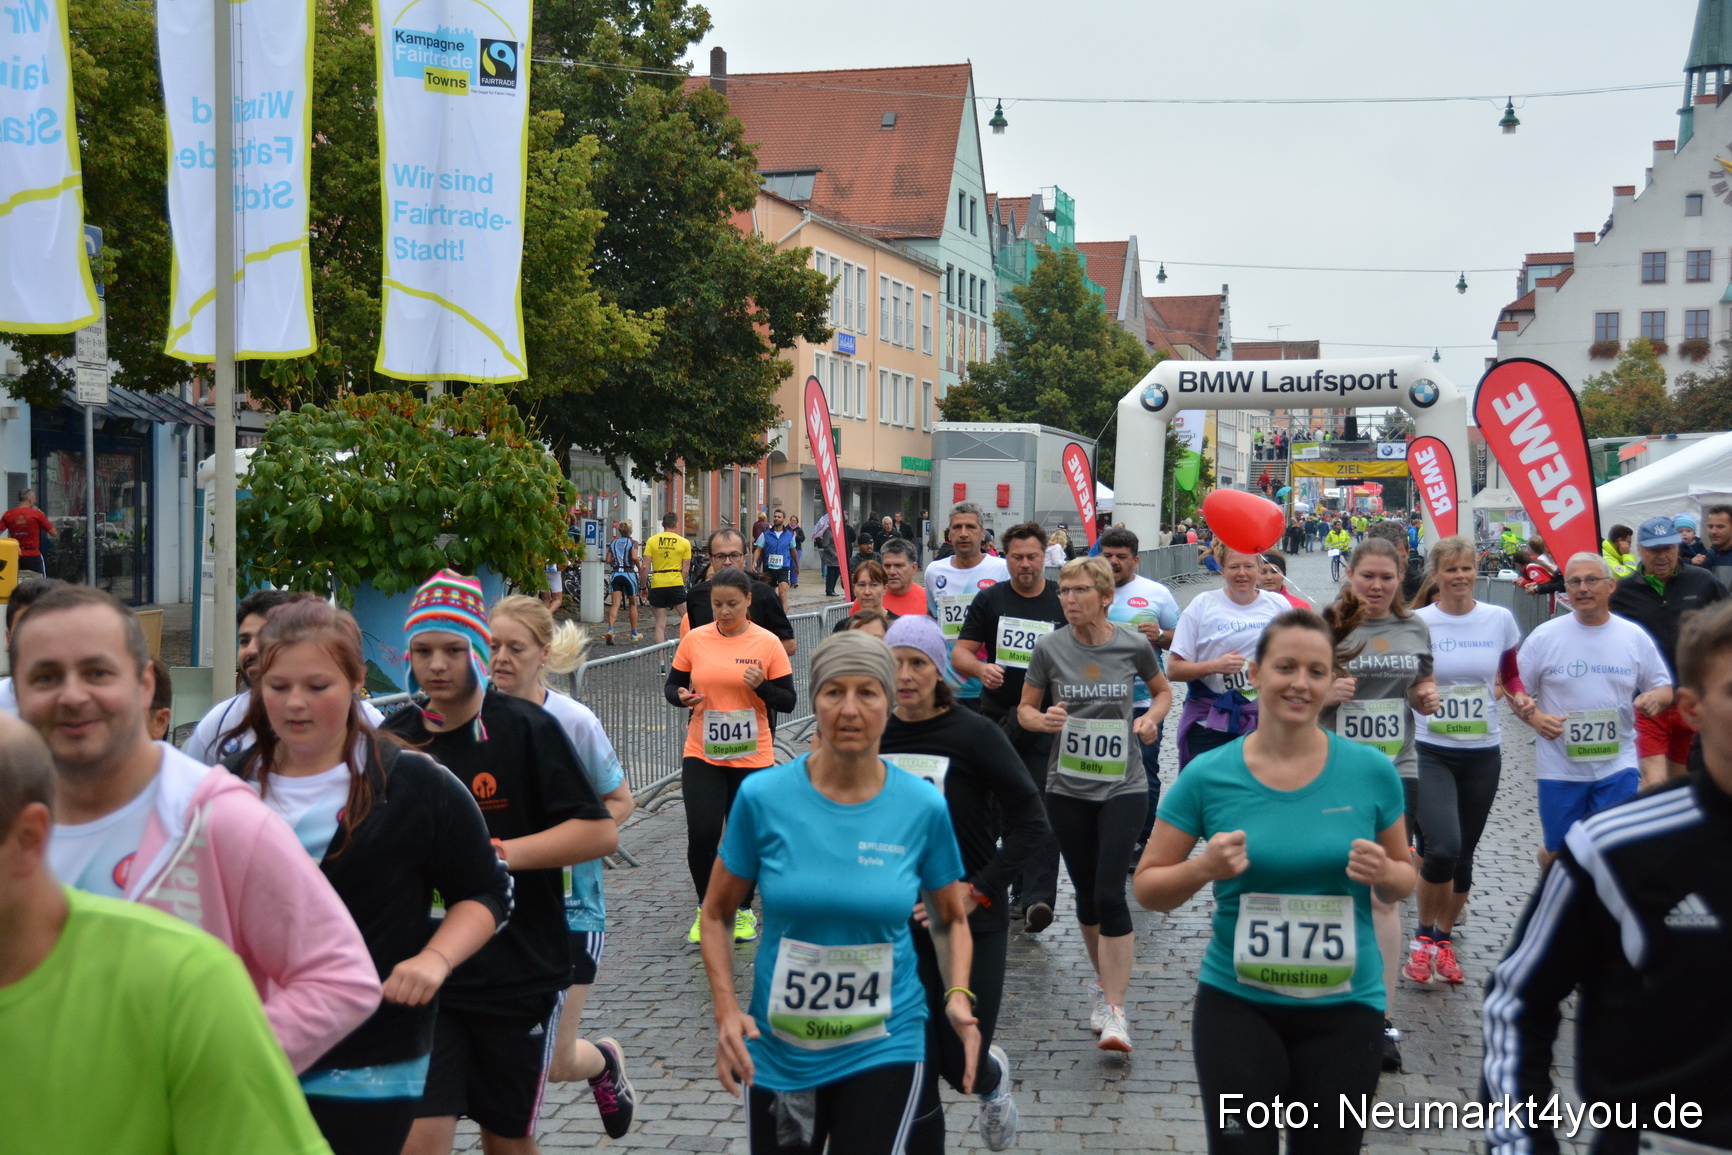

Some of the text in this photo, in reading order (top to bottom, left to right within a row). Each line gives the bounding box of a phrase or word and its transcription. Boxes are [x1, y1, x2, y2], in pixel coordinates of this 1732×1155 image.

[395, 31, 465, 52] Kampagne
[395, 44, 474, 69] Fairtrade
[425, 72, 467, 88] Towns
[481, 77, 516, 87] FAIRTRADE
[392, 163, 493, 194] Wir sind
[394, 200, 512, 231] Fairtrade-
[394, 236, 464, 261] Stadt!
[1179, 369, 1398, 396] BMW Laufsport
[810, 397, 842, 535] REWE
[1491, 382, 1586, 532] REWE
[1337, 464, 1363, 474] ZIEL
[1067, 453, 1094, 523] REWE
[1415, 446, 1453, 517] REWE
[587, 524, 595, 536] P
[658, 536, 678, 547] MTP
[944, 605, 972, 622] 524
[1002, 628, 1044, 651] 528
[1458, 640, 1494, 649] NEUMARKT
[1009, 651, 1032, 662] Marku
[1590, 665, 1632, 677] NEUMARKT
[1057, 683, 1128, 698] LEHMEIER
[1434, 697, 1483, 719] 5012
[708, 720, 752, 741] 5041
[1344, 714, 1400, 738] 5063
[1446, 723, 1471, 733] Esther
[1570, 720, 1616, 743] 5278
[713, 743, 748, 755] Stephanie
[1066, 731, 1122, 758] 5106
[1577, 746, 1612, 755] Christian
[1080, 761, 1103, 774] Betty
[1247, 919, 1345, 961] 5175
[827, 948, 882, 961] BOCK
[1259, 967, 1328, 985] Christine
[783, 968, 880, 1010] 5254
[805, 1020, 853, 1040] Sylvia
